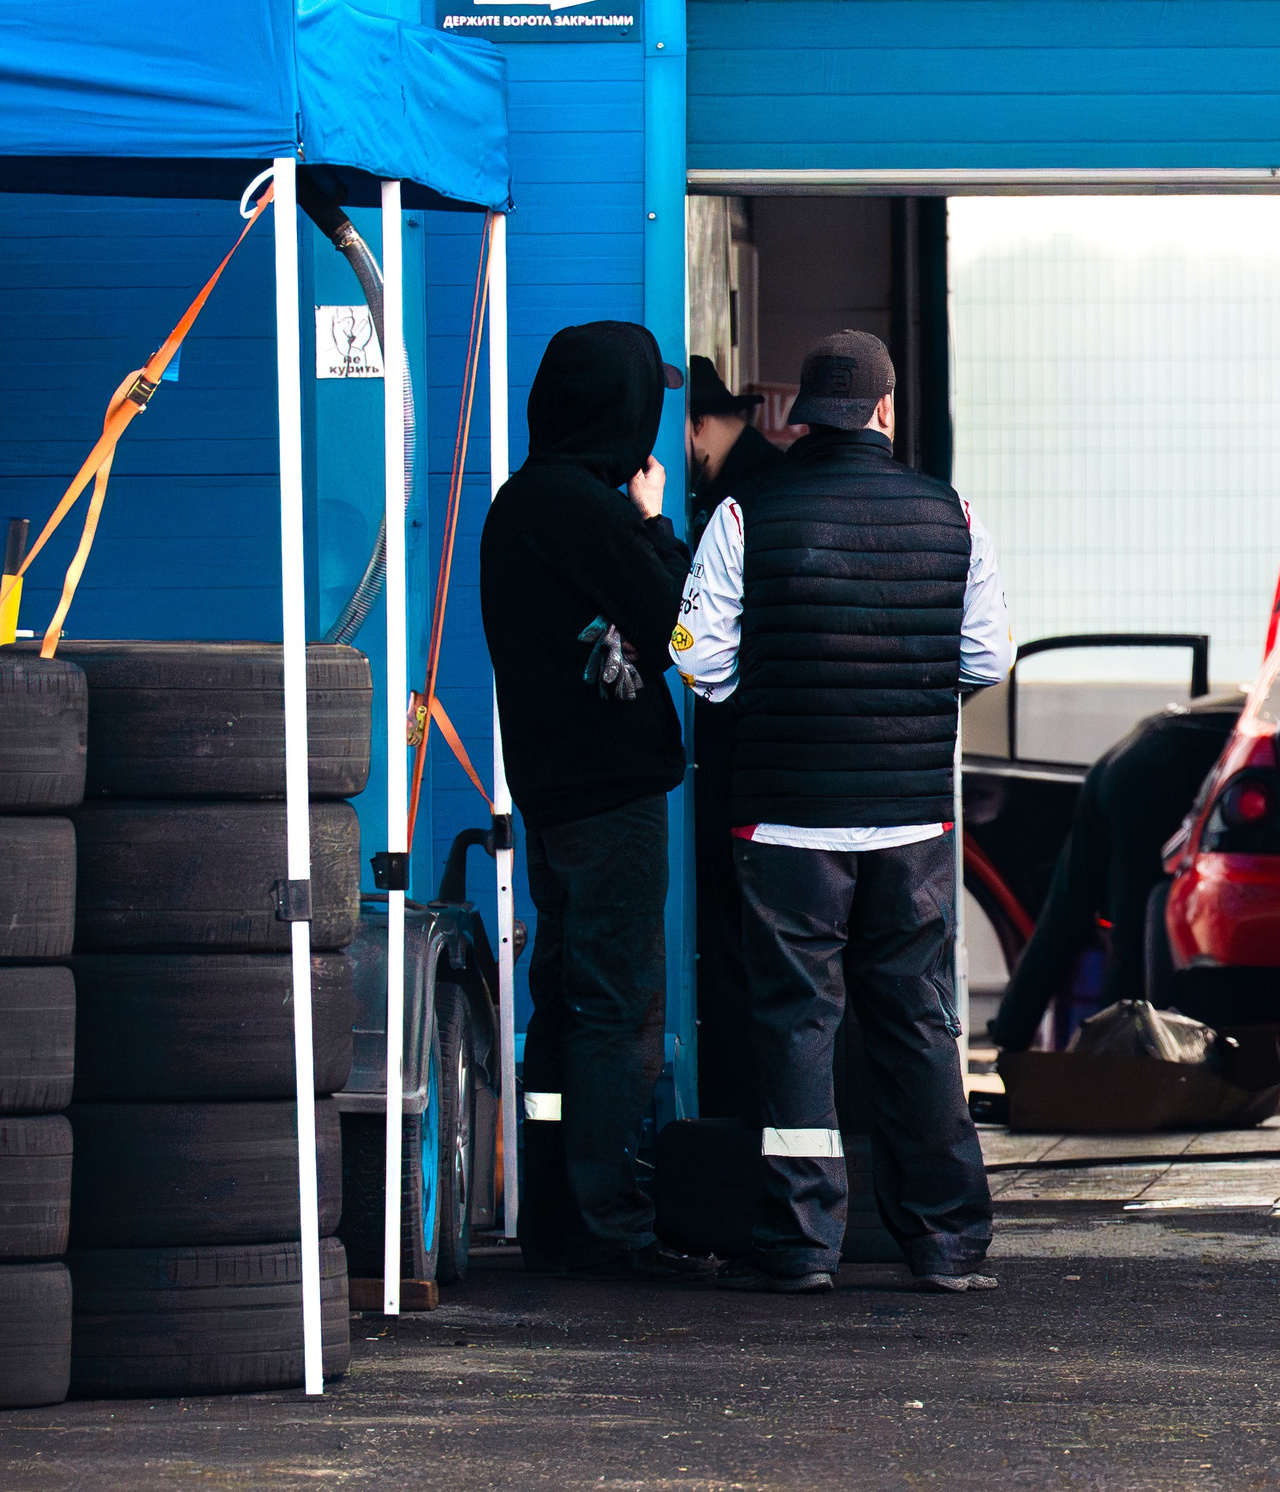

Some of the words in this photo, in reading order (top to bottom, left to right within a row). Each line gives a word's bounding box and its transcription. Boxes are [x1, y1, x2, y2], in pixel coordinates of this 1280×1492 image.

[443, 15, 500, 29] ДЕРЖИТЕ
[503, 15, 552, 26] ВОРОТА
[554, 15, 634, 26] ЗАКРЫТЫМИ
